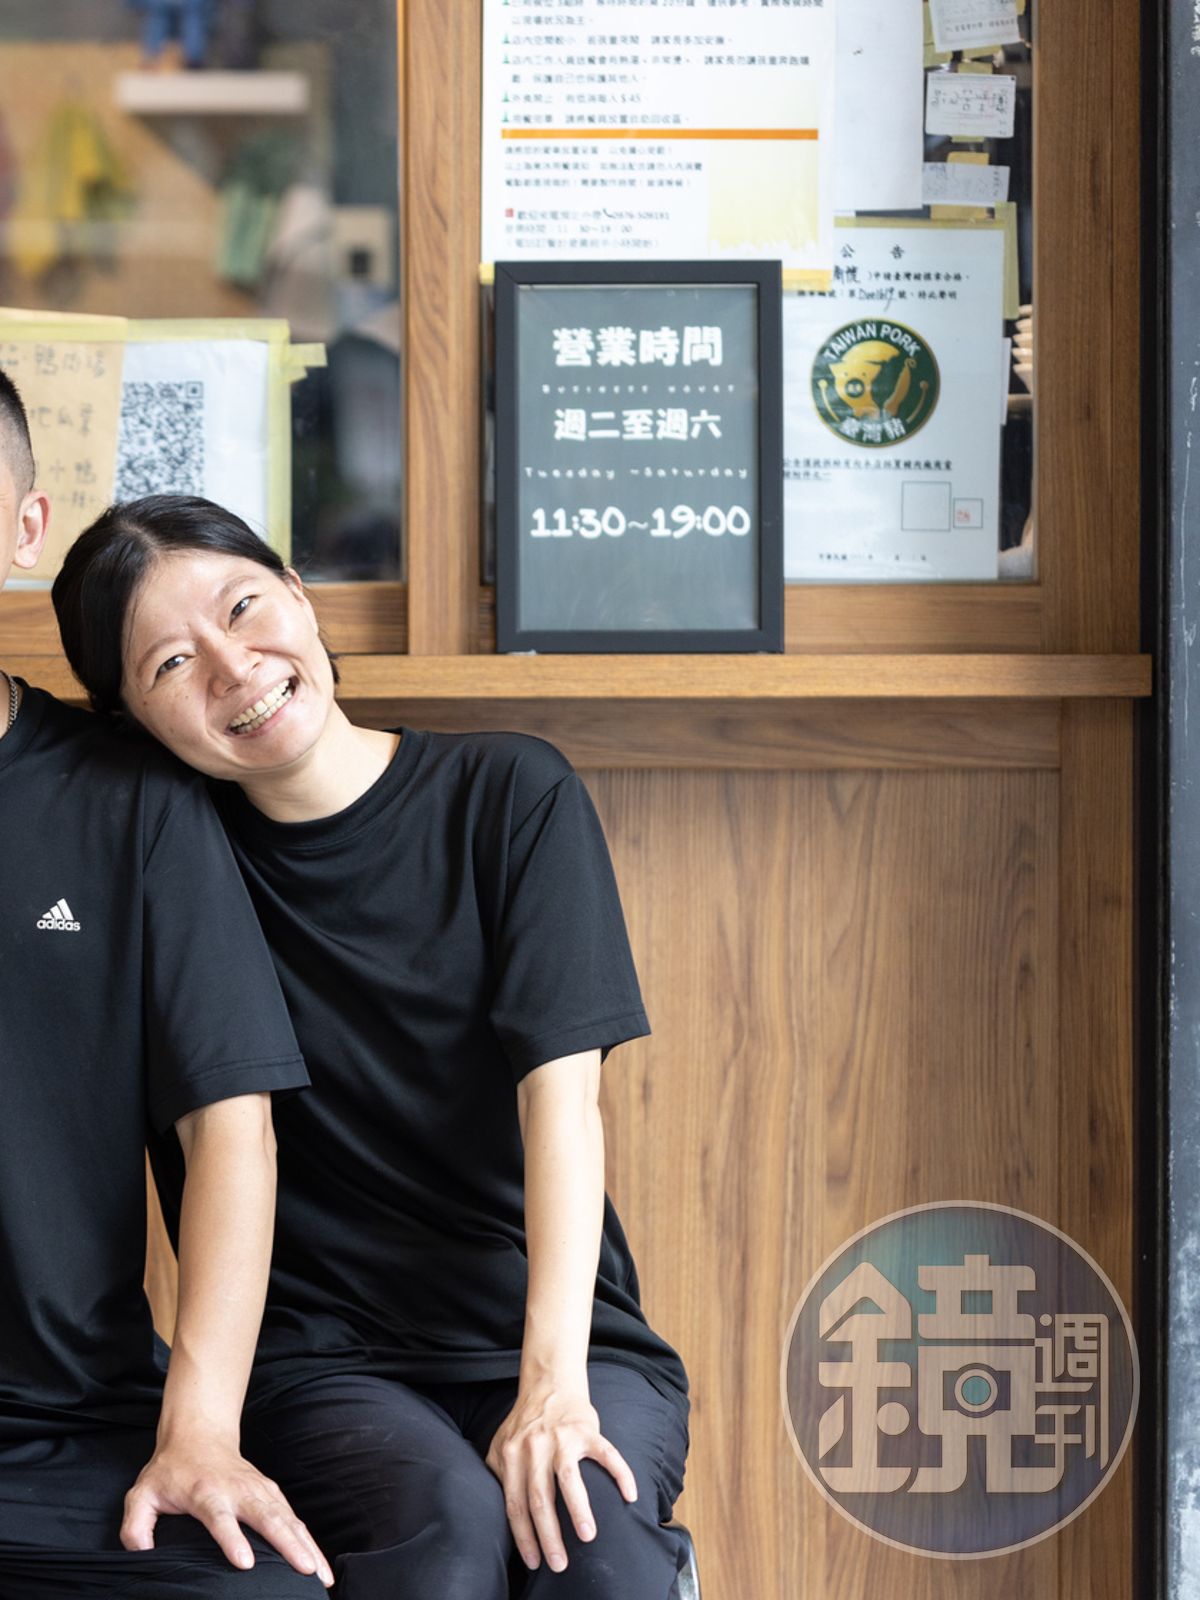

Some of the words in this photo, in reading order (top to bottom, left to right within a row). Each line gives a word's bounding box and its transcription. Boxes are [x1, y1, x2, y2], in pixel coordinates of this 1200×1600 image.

[552, 326, 723, 367] 營業時間
[823, 322, 877, 360] TAIWAN
[880, 324, 921, 357] PORK
[553, 407, 723, 442] 週二至週六
[524, 466, 616, 481] Tuesday
[530, 503, 751, 540] 11:30~19:00
[36, 919, 81, 932] adidas
